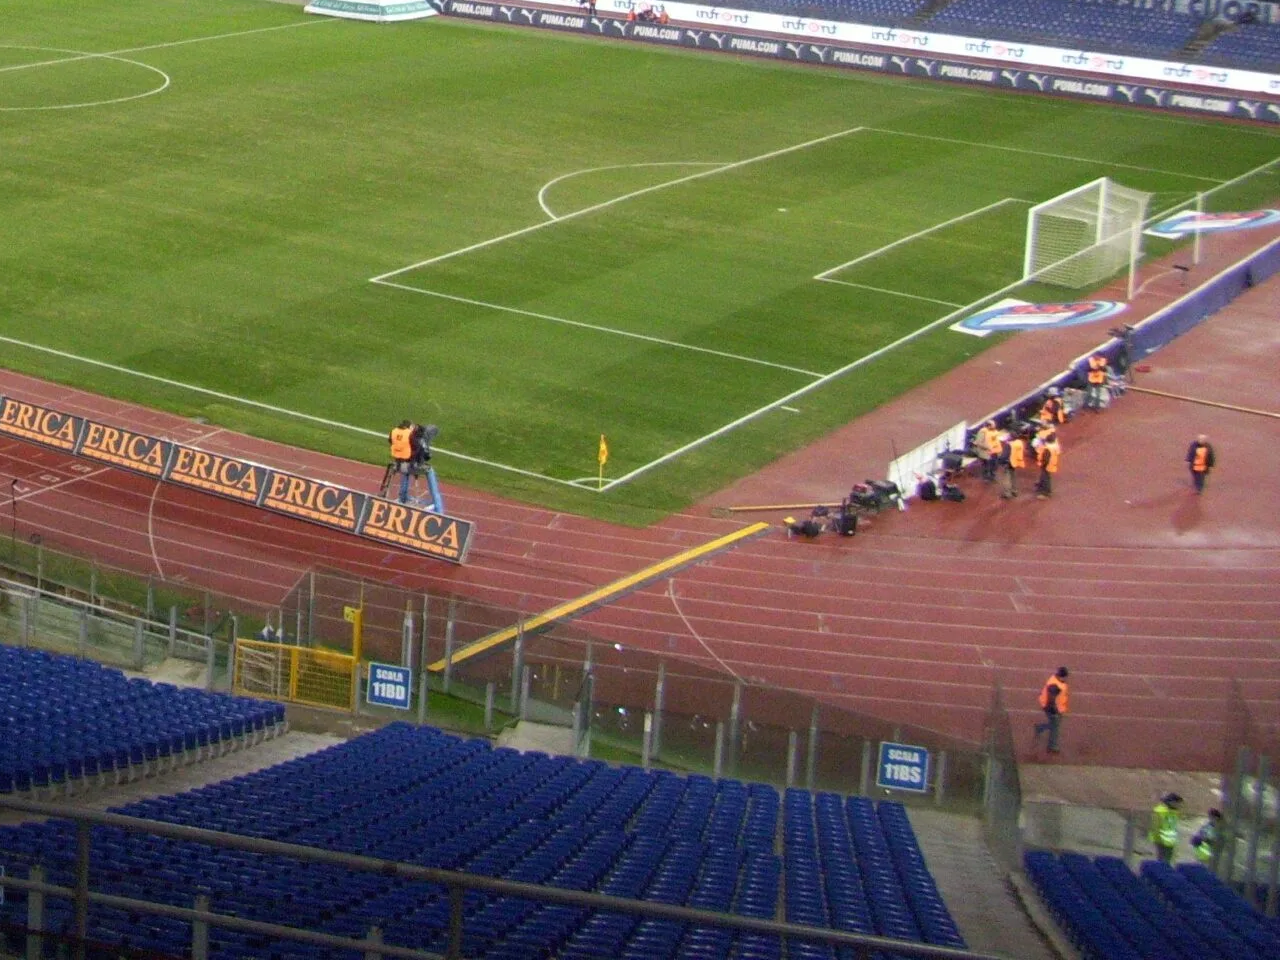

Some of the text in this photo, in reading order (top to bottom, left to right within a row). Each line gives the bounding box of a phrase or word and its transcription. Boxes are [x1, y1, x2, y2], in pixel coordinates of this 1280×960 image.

[451, 2, 493, 16] PUMA.COM
[540, 13, 584, 29] PUMA.COM
[633, 25, 680, 41] PUMA.COM
[731, 38, 778, 54] PUMA.COM
[833, 51, 883, 68] PUMA.COM
[940, 64, 993, 81] PUMA.COM
[2, 399, 75, 442] ERICA
[82, 423, 163, 467] ERICA
[174, 448, 258, 494] ERICA
[270, 473, 356, 521] ERICA
[366, 499, 459, 549] ERICA
[375, 668, 403, 683] SCALA
[372, 681, 406, 701] 11BD
[888, 748, 920, 763] SCALA
[884, 762, 921, 783] 11BS
